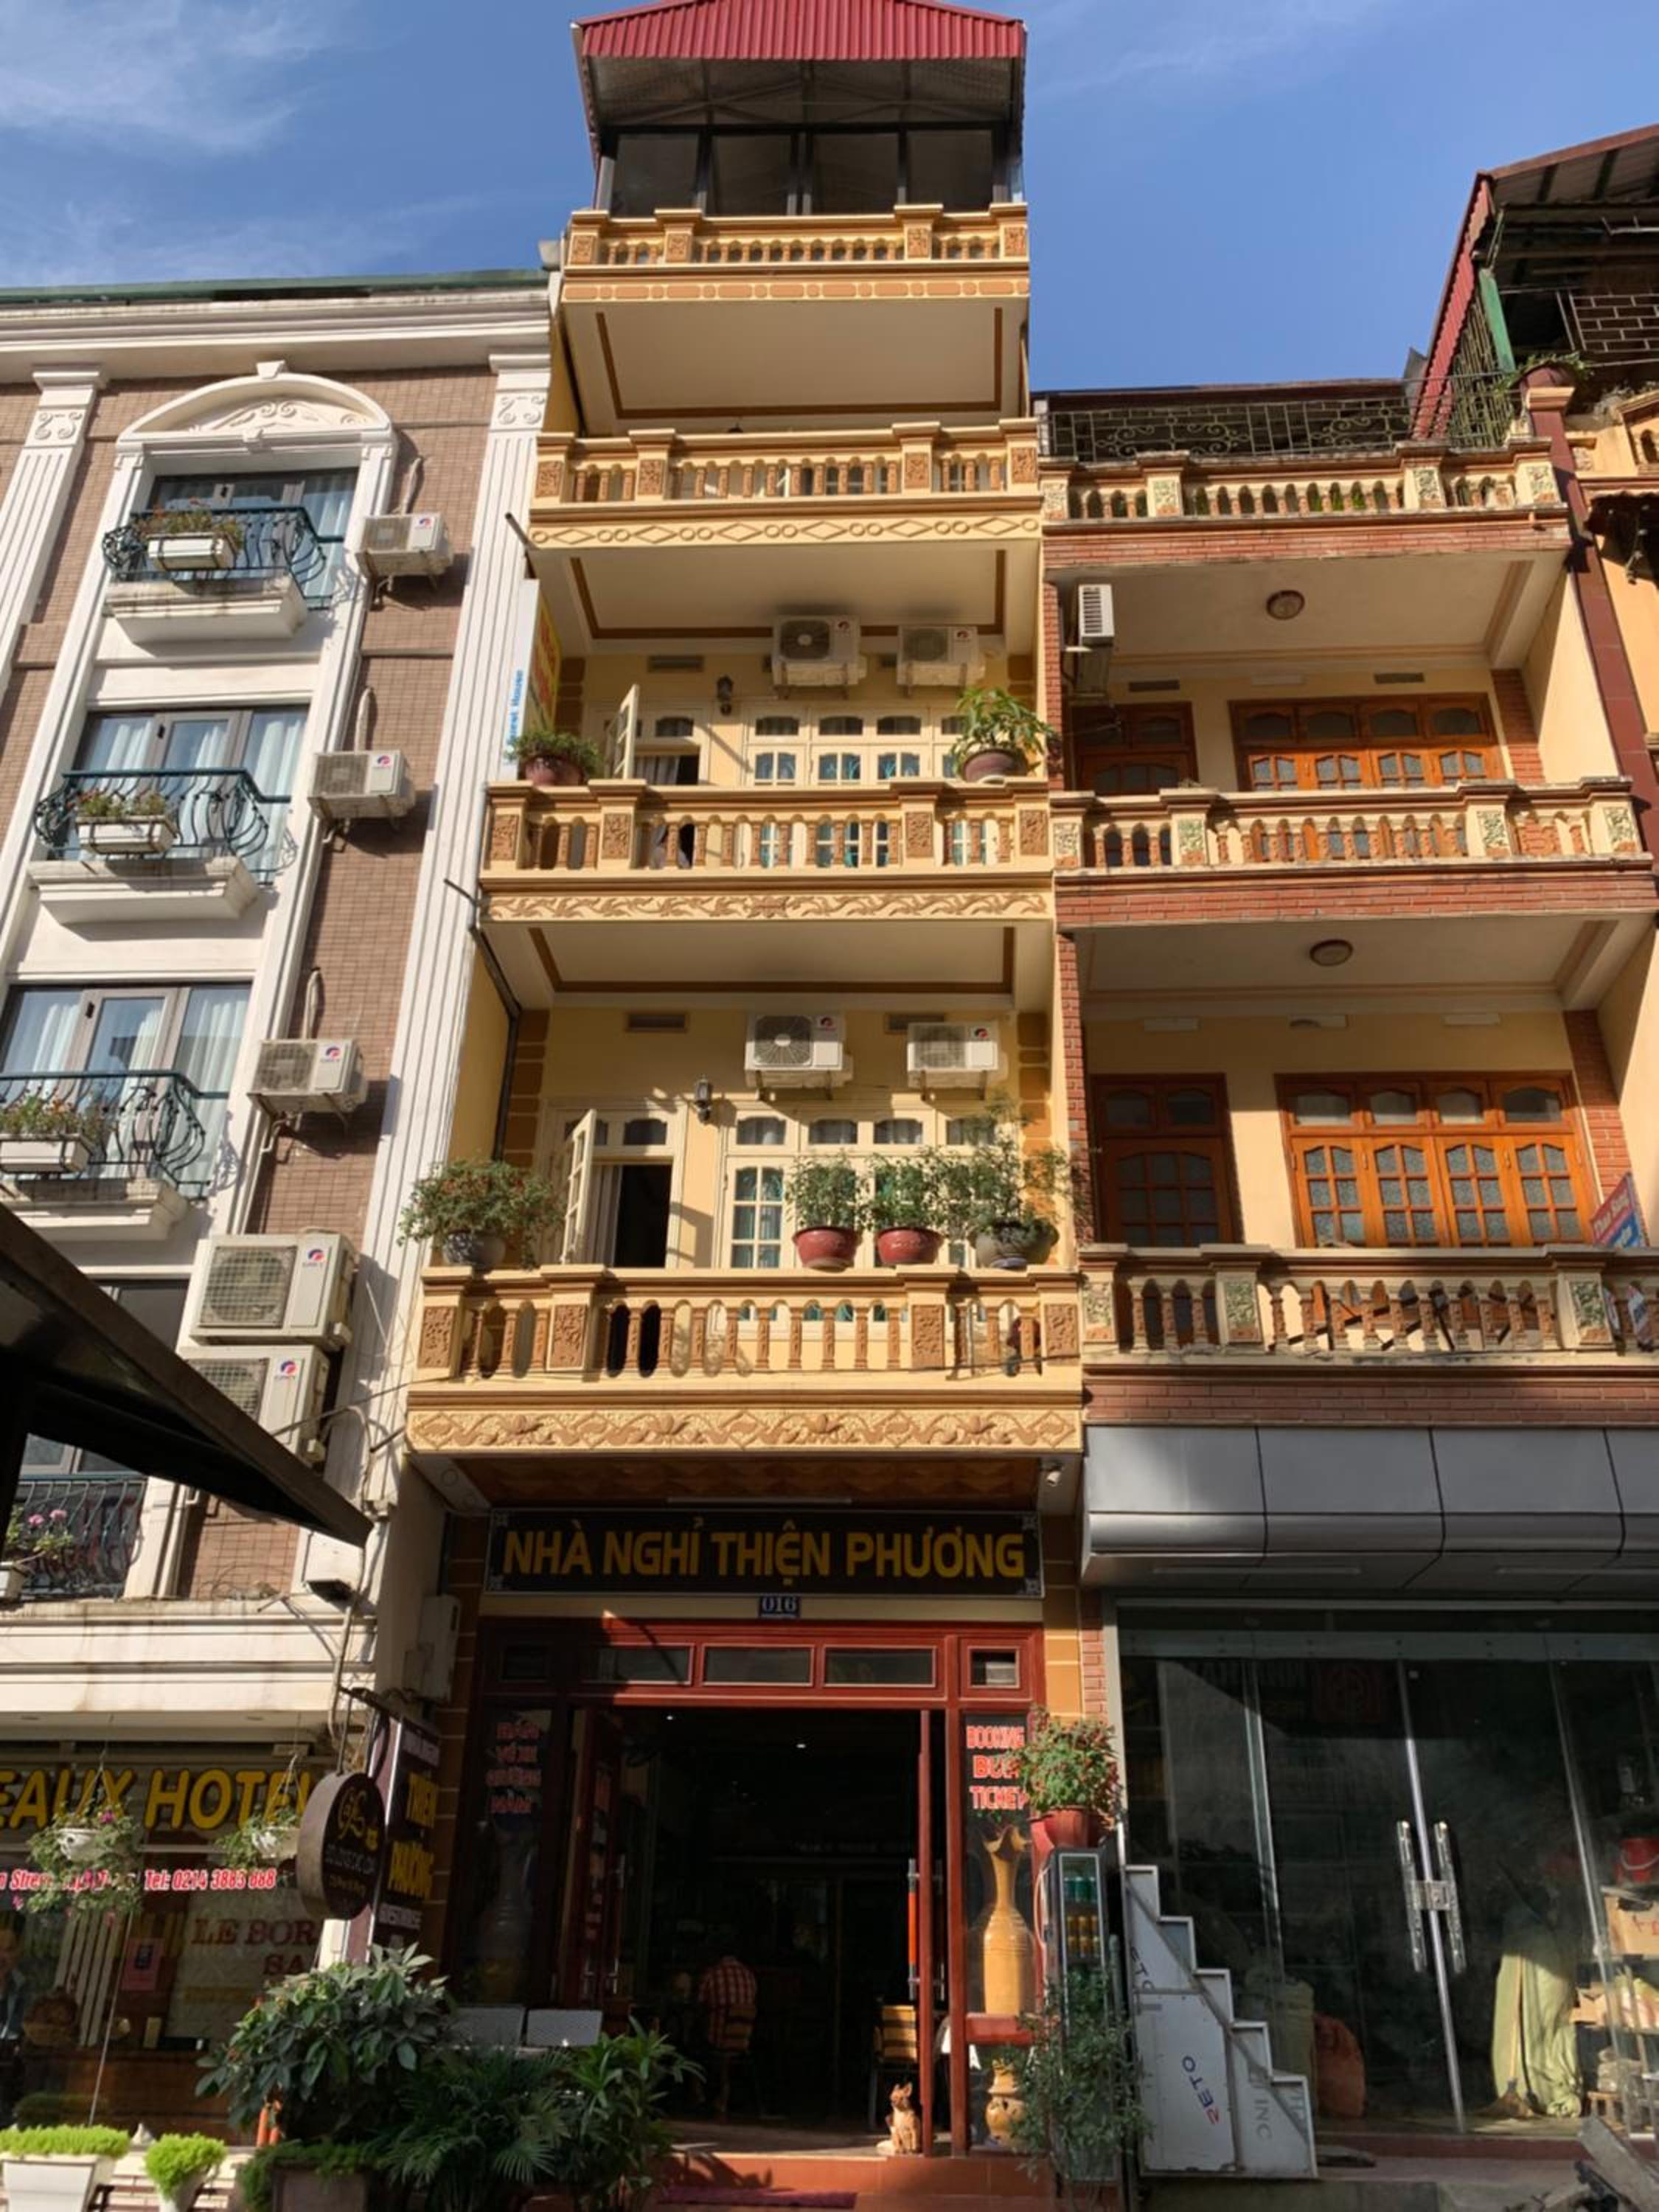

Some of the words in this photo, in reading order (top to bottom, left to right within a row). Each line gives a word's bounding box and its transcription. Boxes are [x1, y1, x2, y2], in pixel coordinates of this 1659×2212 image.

[503, 1519, 592, 1575] NHÀ
[602, 1517, 704, 1576] NGHỈ
[710, 1519, 830, 1586] THIỆN
[846, 1526, 1025, 1578] PHƯƠNG
[762, 1597, 796, 1612] 016
[144, 1869, 171, 1891] Tel:
[190, 1919, 237, 1945] LE
